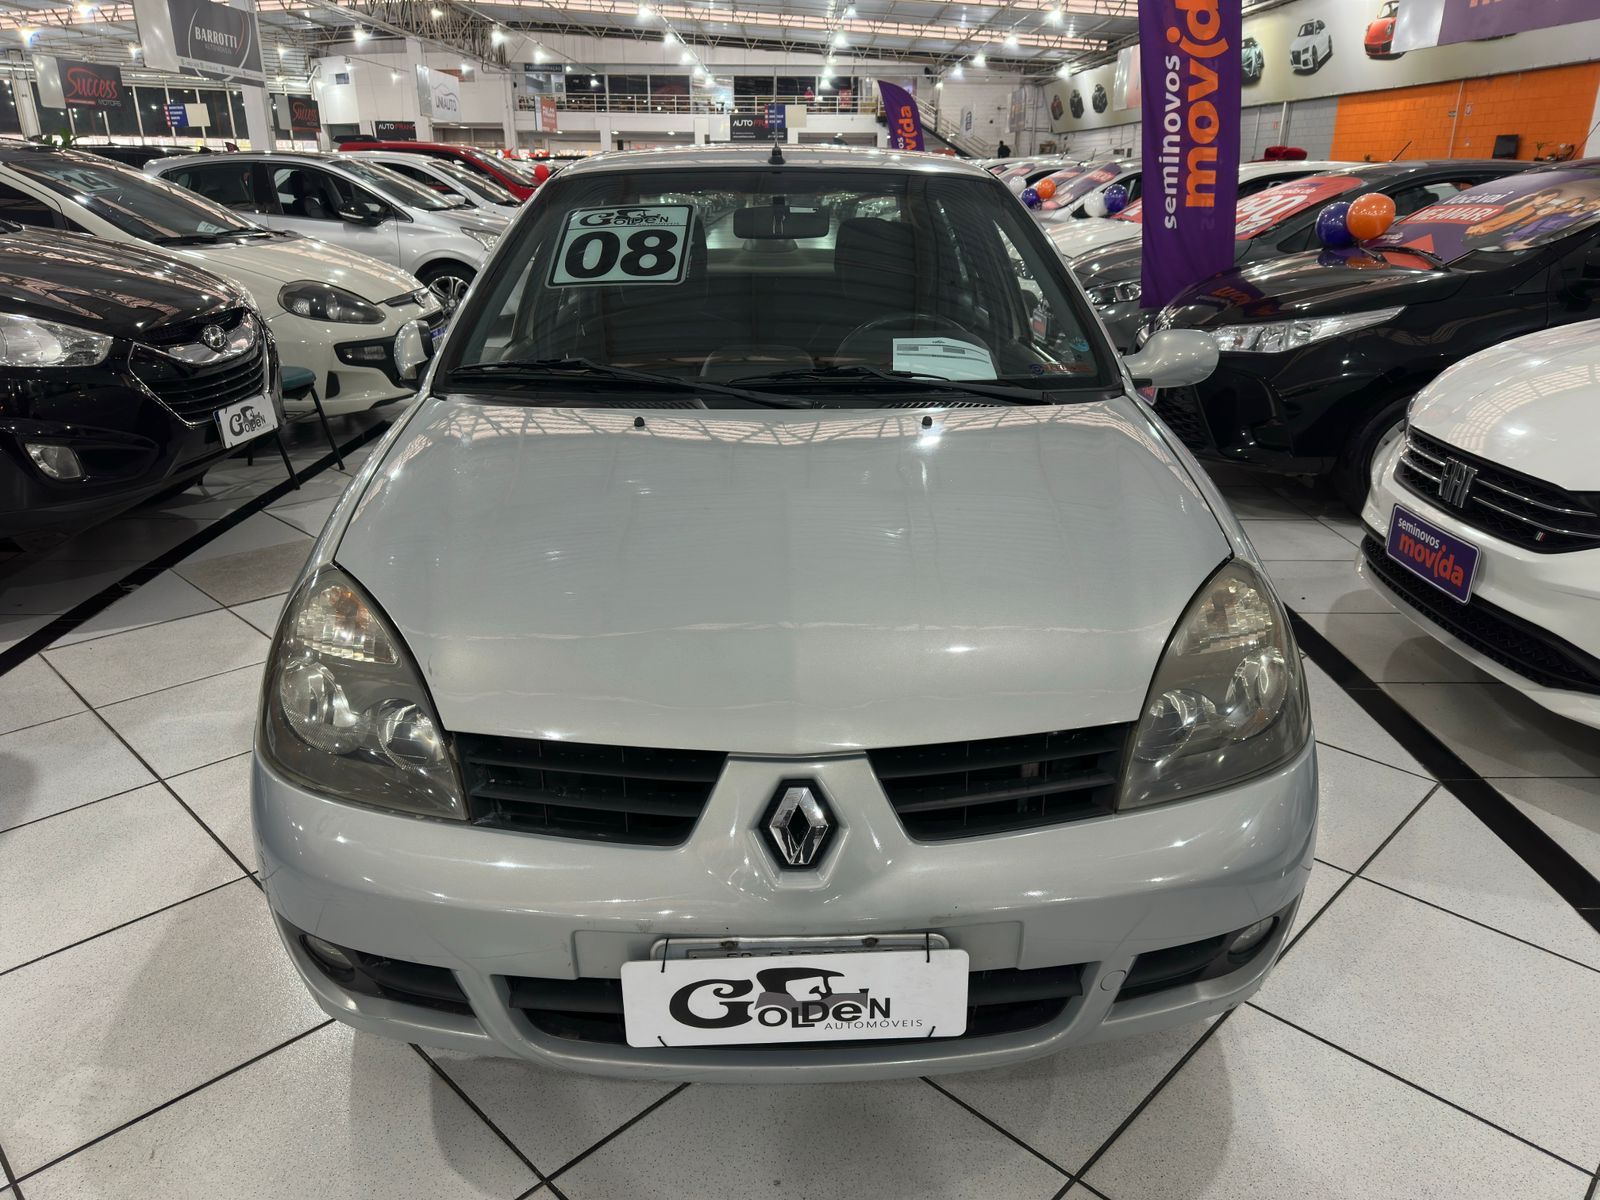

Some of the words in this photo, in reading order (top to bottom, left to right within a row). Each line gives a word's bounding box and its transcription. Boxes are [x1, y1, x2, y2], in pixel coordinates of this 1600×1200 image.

[194, 26, 238, 49] BARROTTI
[67, 66, 118, 99] Success
[732, 119, 753, 127] AUTO
[1158, 54, 1182, 230] seminovos
[564, 229, 678, 279] 08
[1397, 517, 1441, 549] seminovos
[1399, 533, 1465, 587] movida
[824, 1018, 923, 1031] AUTOMÓVEIS
